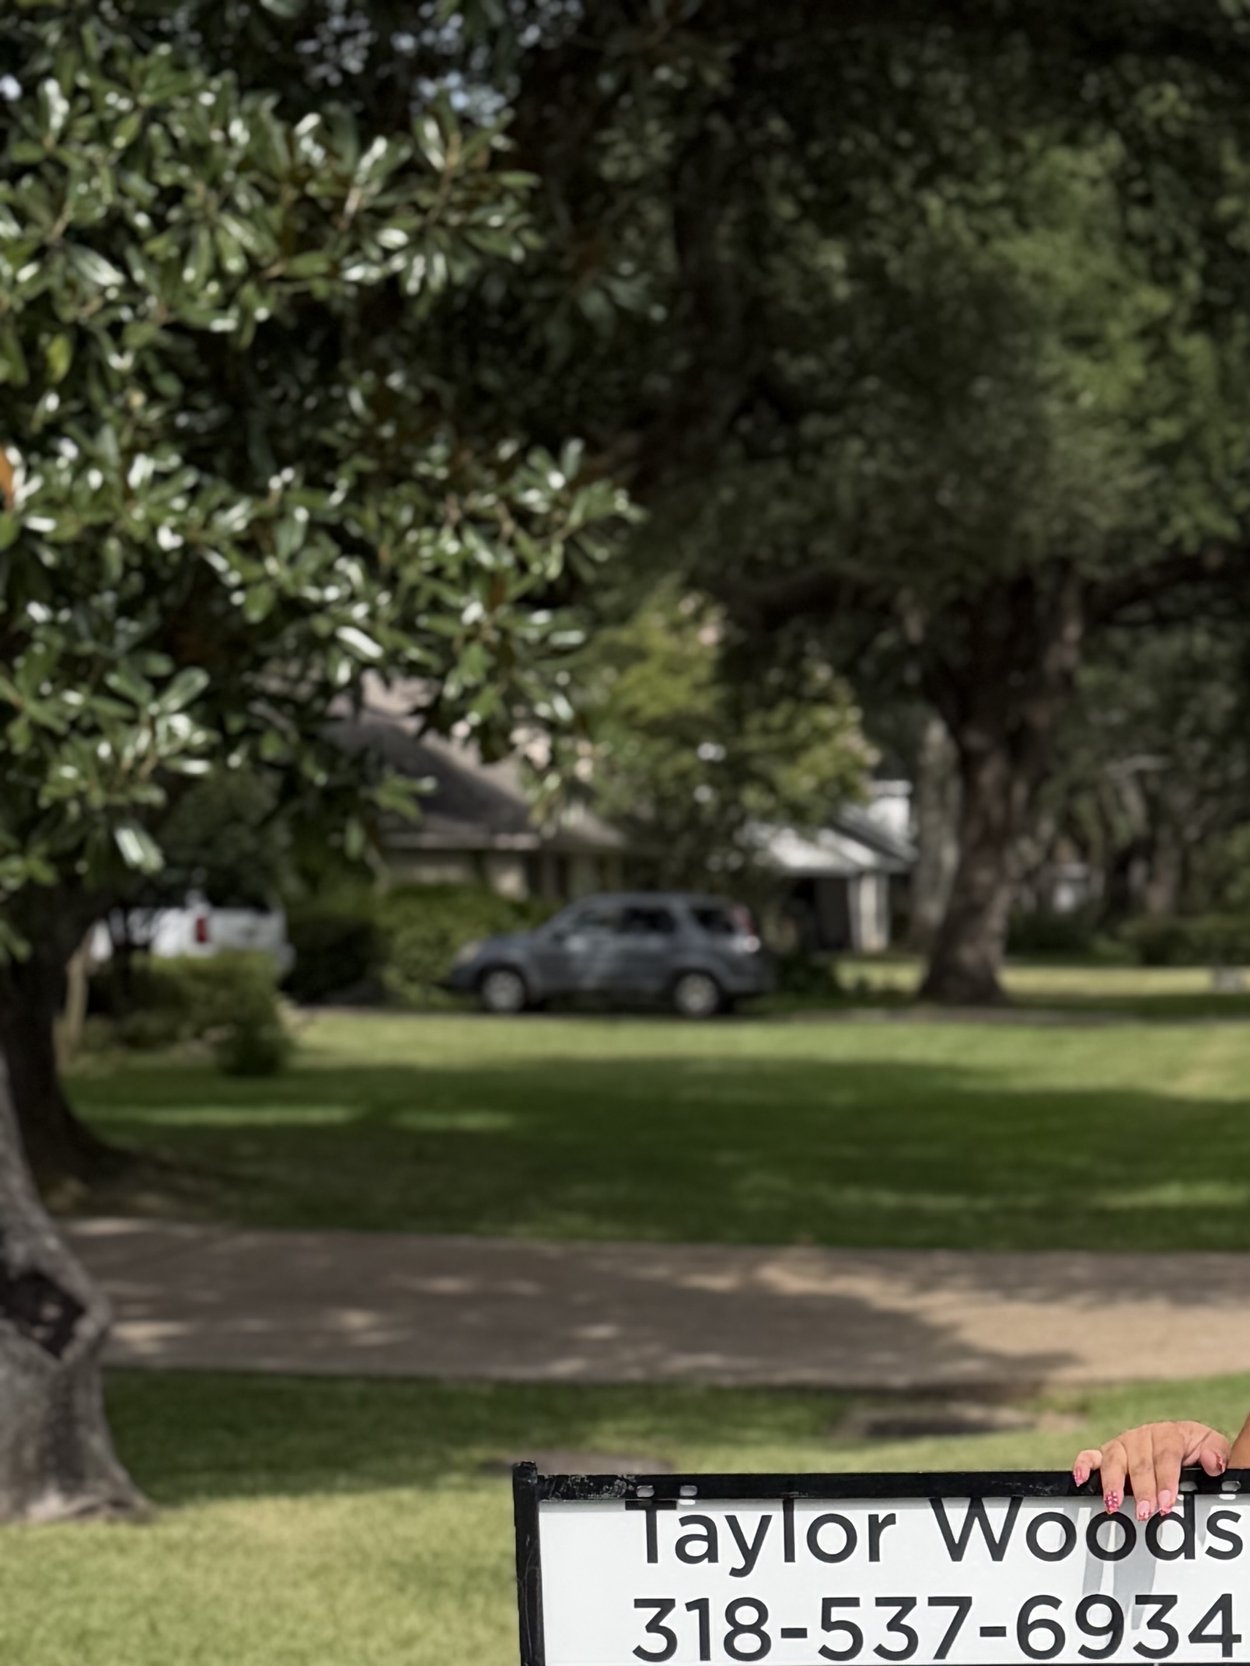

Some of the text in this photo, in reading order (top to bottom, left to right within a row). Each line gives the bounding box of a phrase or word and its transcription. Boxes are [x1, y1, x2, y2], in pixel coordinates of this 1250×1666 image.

[624, 1493, 1244, 1578] Taylor Woods
[632, 1593, 1242, 1662] 318-537-6934
